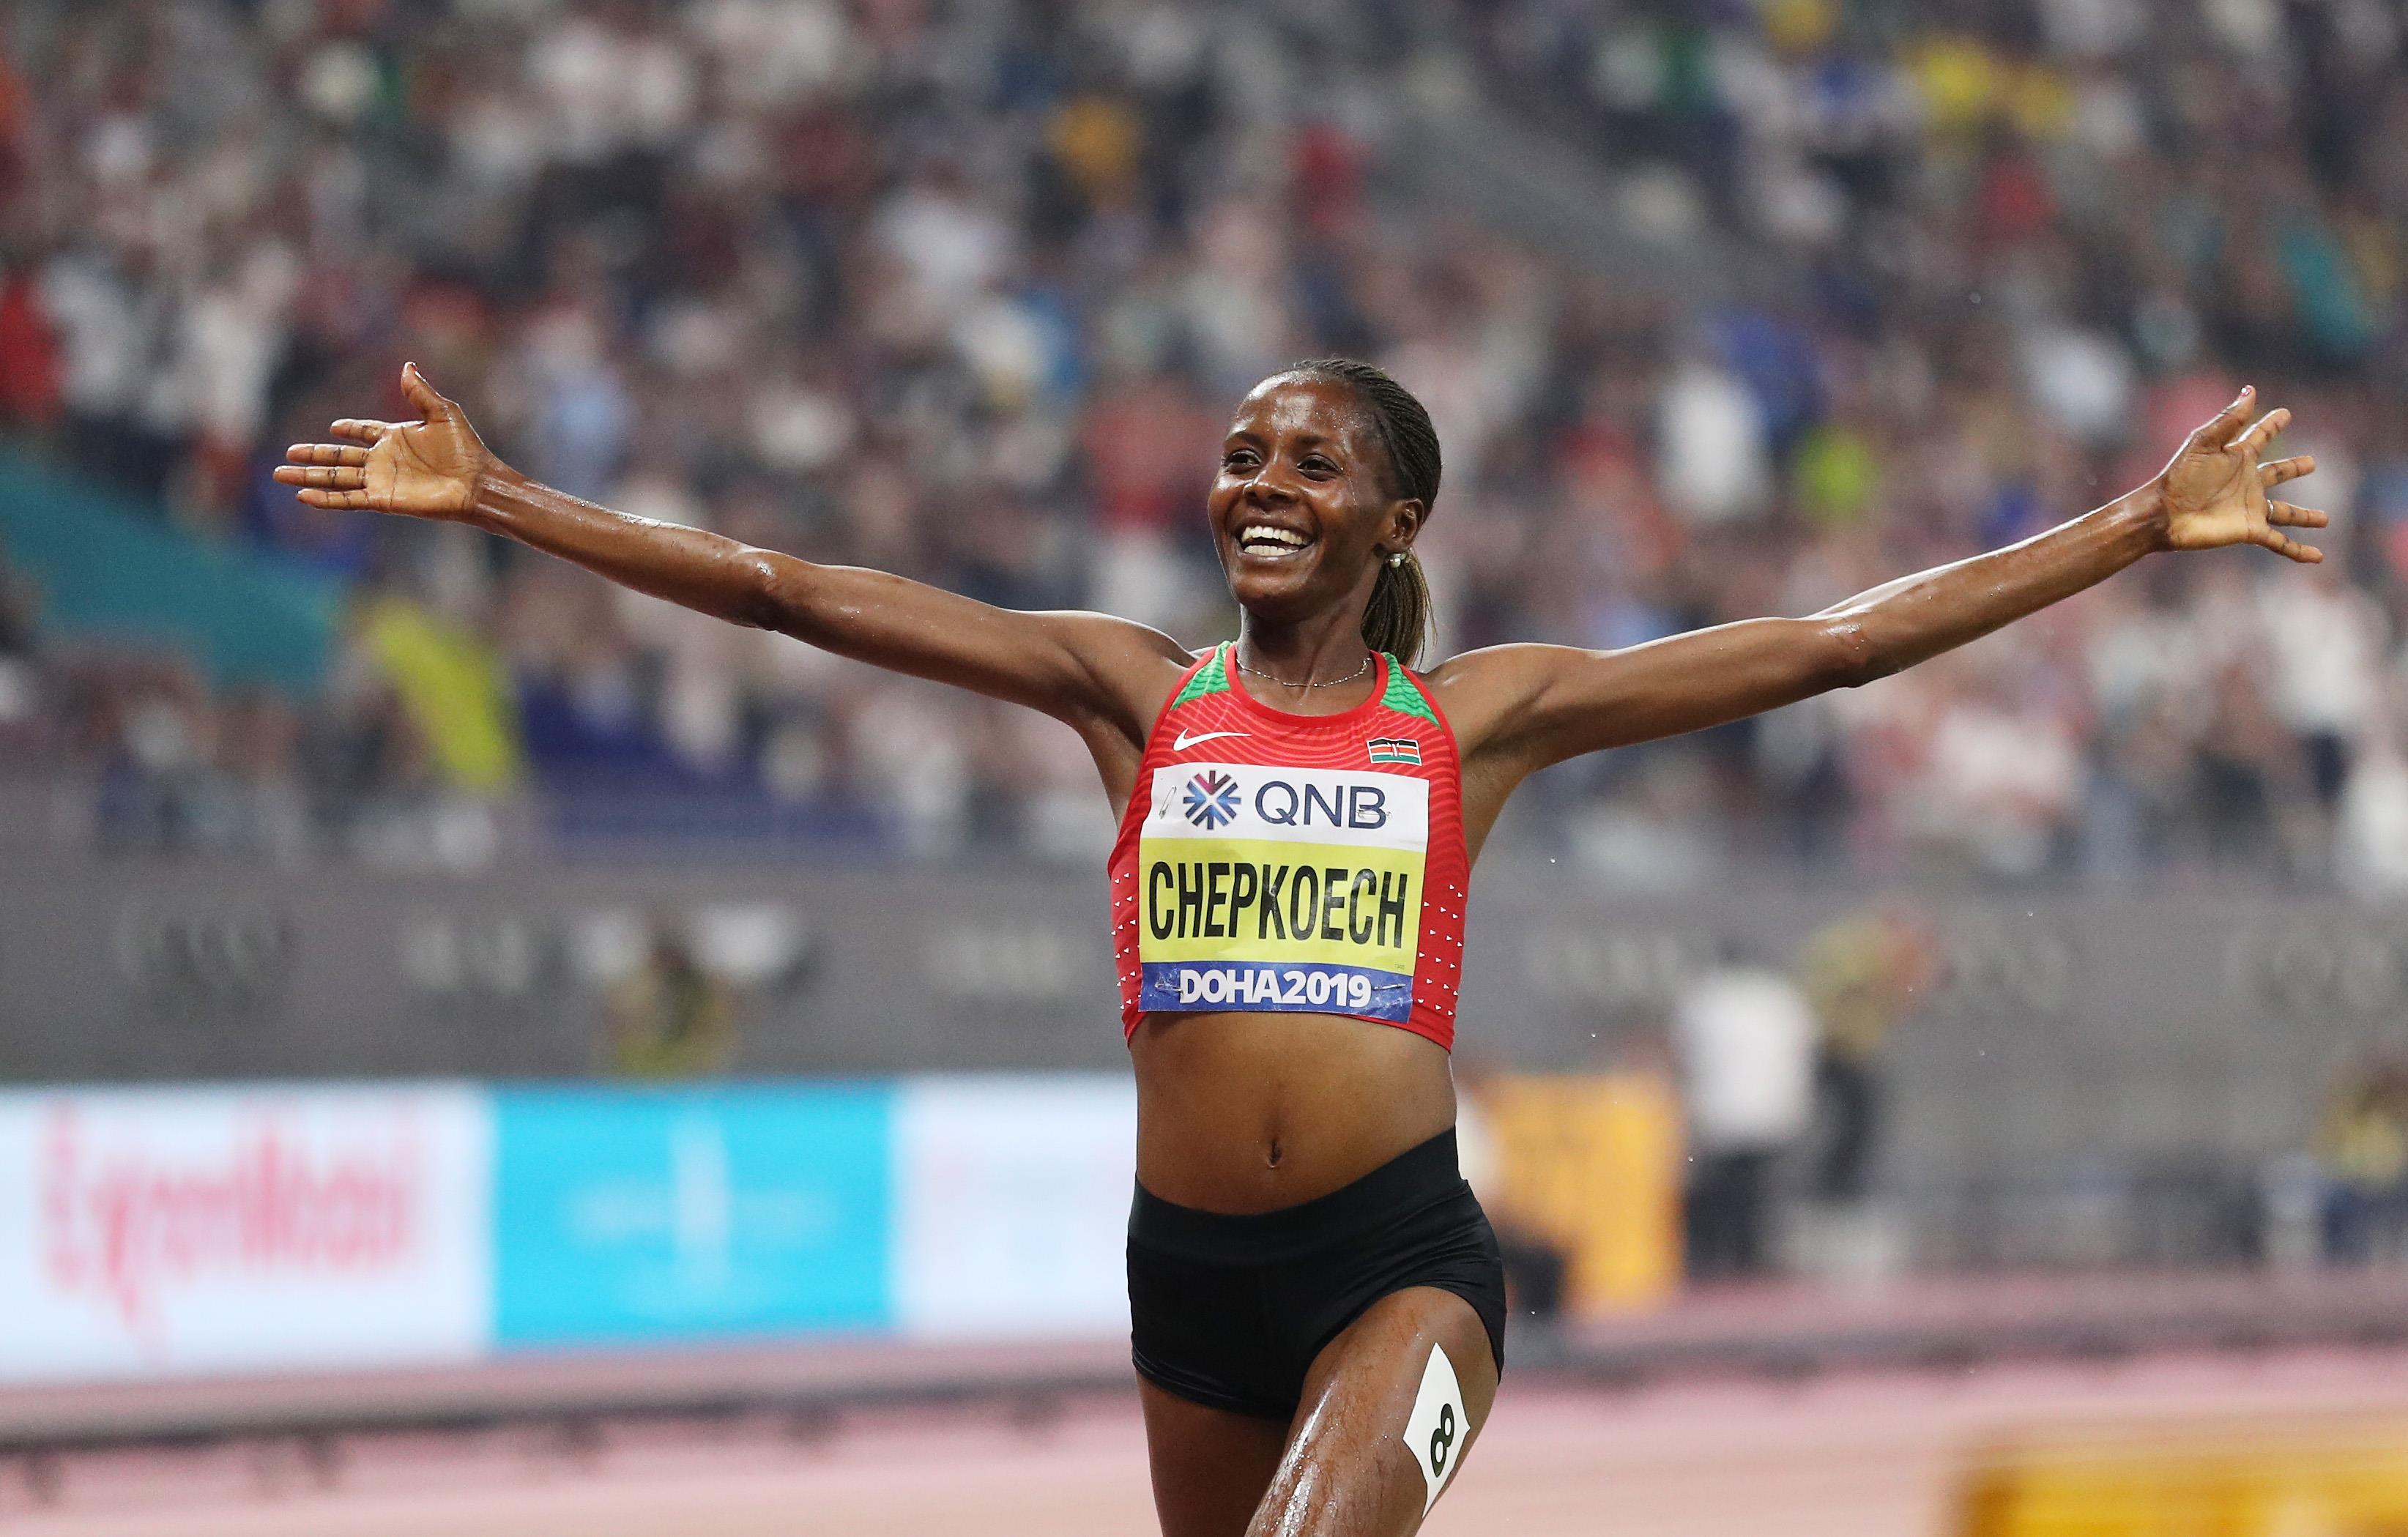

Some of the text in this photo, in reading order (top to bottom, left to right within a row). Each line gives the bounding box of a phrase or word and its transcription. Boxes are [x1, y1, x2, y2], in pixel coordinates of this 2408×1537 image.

[1255, 781, 1386, 829] QNB
[1148, 861, 1408, 948] CHEPKOECH
[1180, 969, 1372, 1008] DOHA2019
[1430, 1403, 1455, 1478] 8
